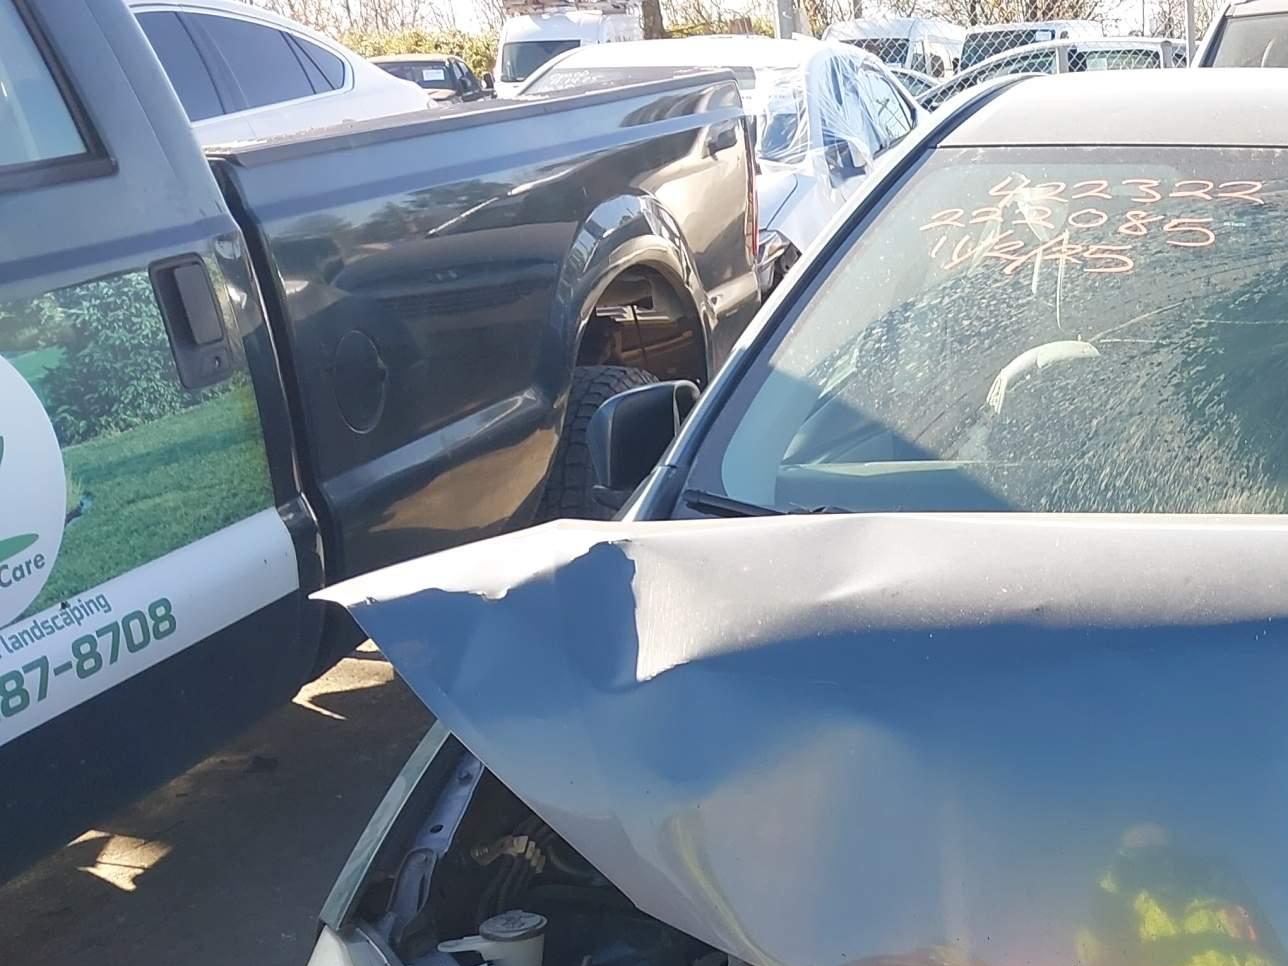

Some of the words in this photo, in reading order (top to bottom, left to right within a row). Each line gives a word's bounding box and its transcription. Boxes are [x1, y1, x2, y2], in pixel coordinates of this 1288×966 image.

[988, 176, 1264, 208] 422322
[919, 208, 1216, 247] 222085
[0, 553, 46, 588] Care
[0, 593, 113, 653] landscaping
[0, 597, 177, 718] 87-8708
